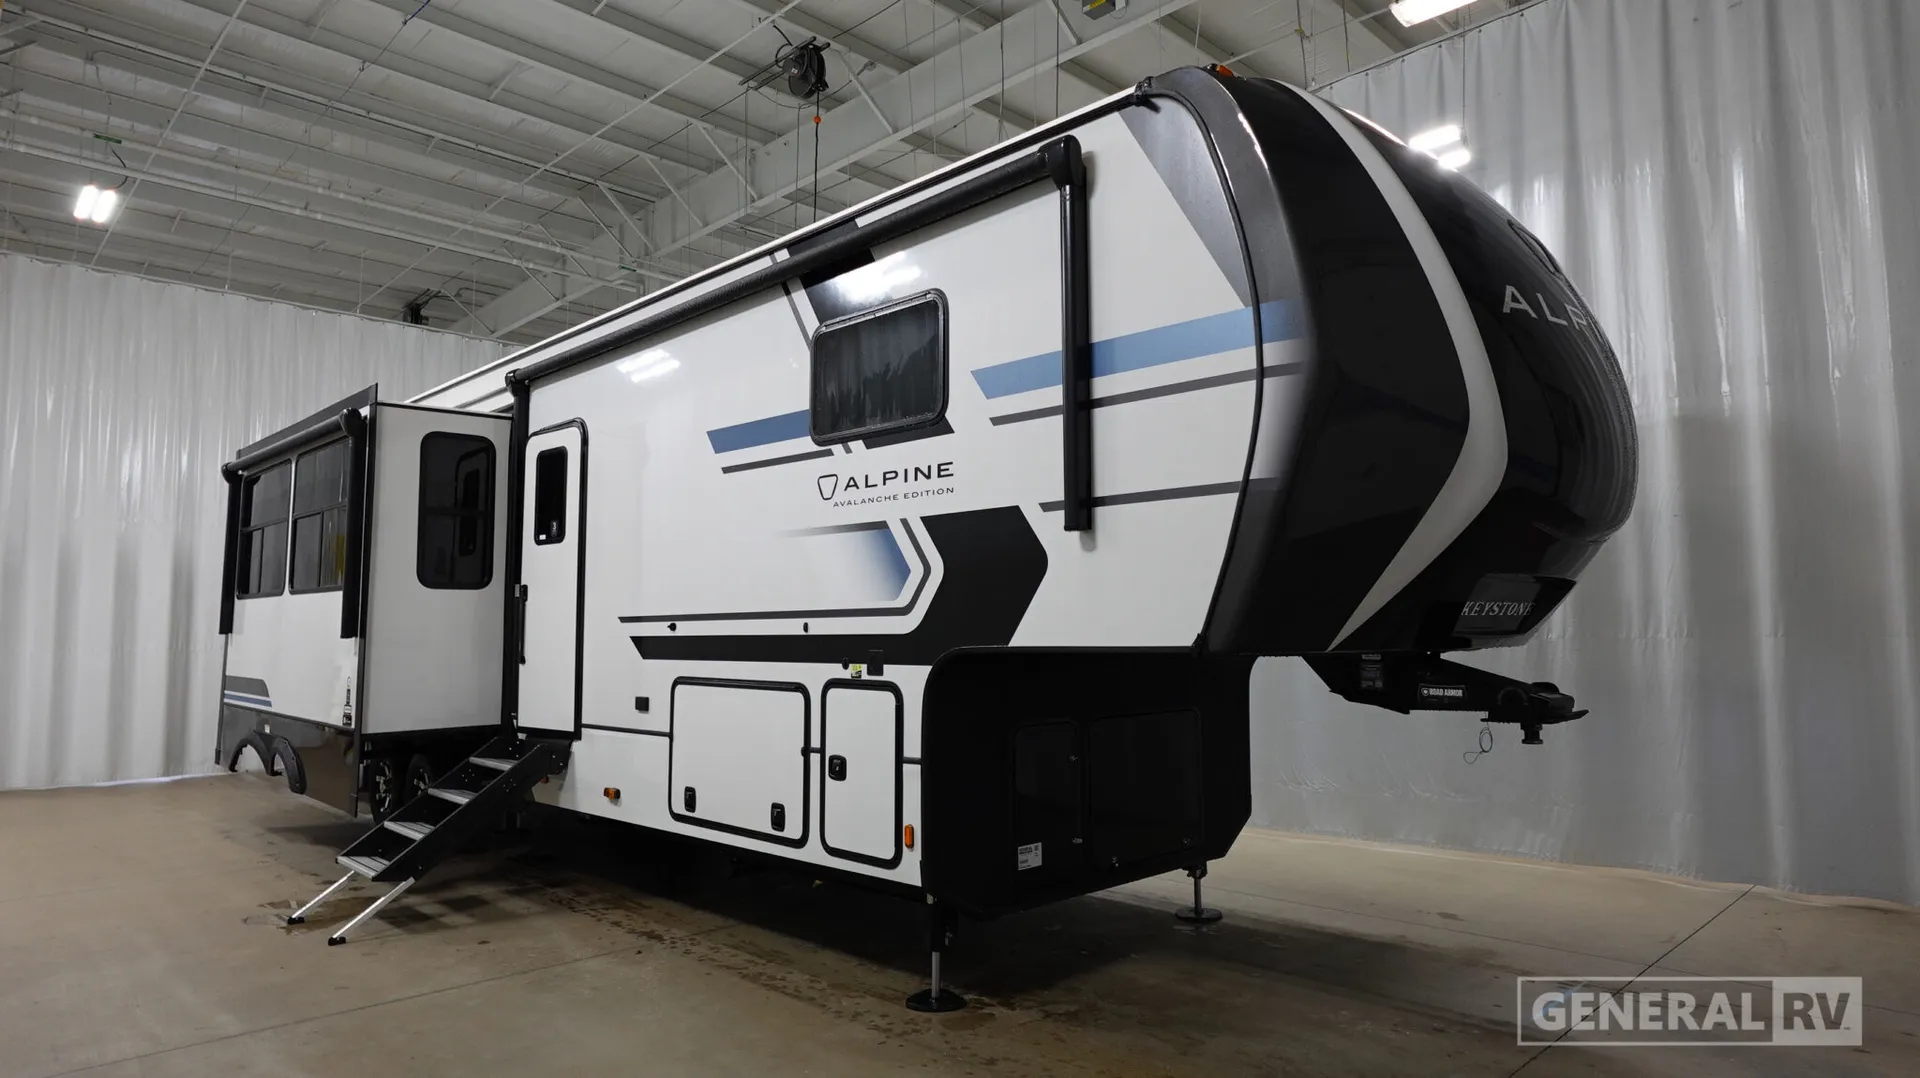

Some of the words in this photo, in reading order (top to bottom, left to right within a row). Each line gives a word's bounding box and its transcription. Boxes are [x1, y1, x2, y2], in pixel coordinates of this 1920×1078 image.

[844, 461, 954, 491] ALPINE
[833, 494, 899, 508] AVALANCHE
[903, 487, 955, 500] EDITION
[1460, 601, 1535, 616] KEYSTONE
[1429, 688, 1443, 696] ROAD
[1444, 688, 1463, 697] ARMOR
